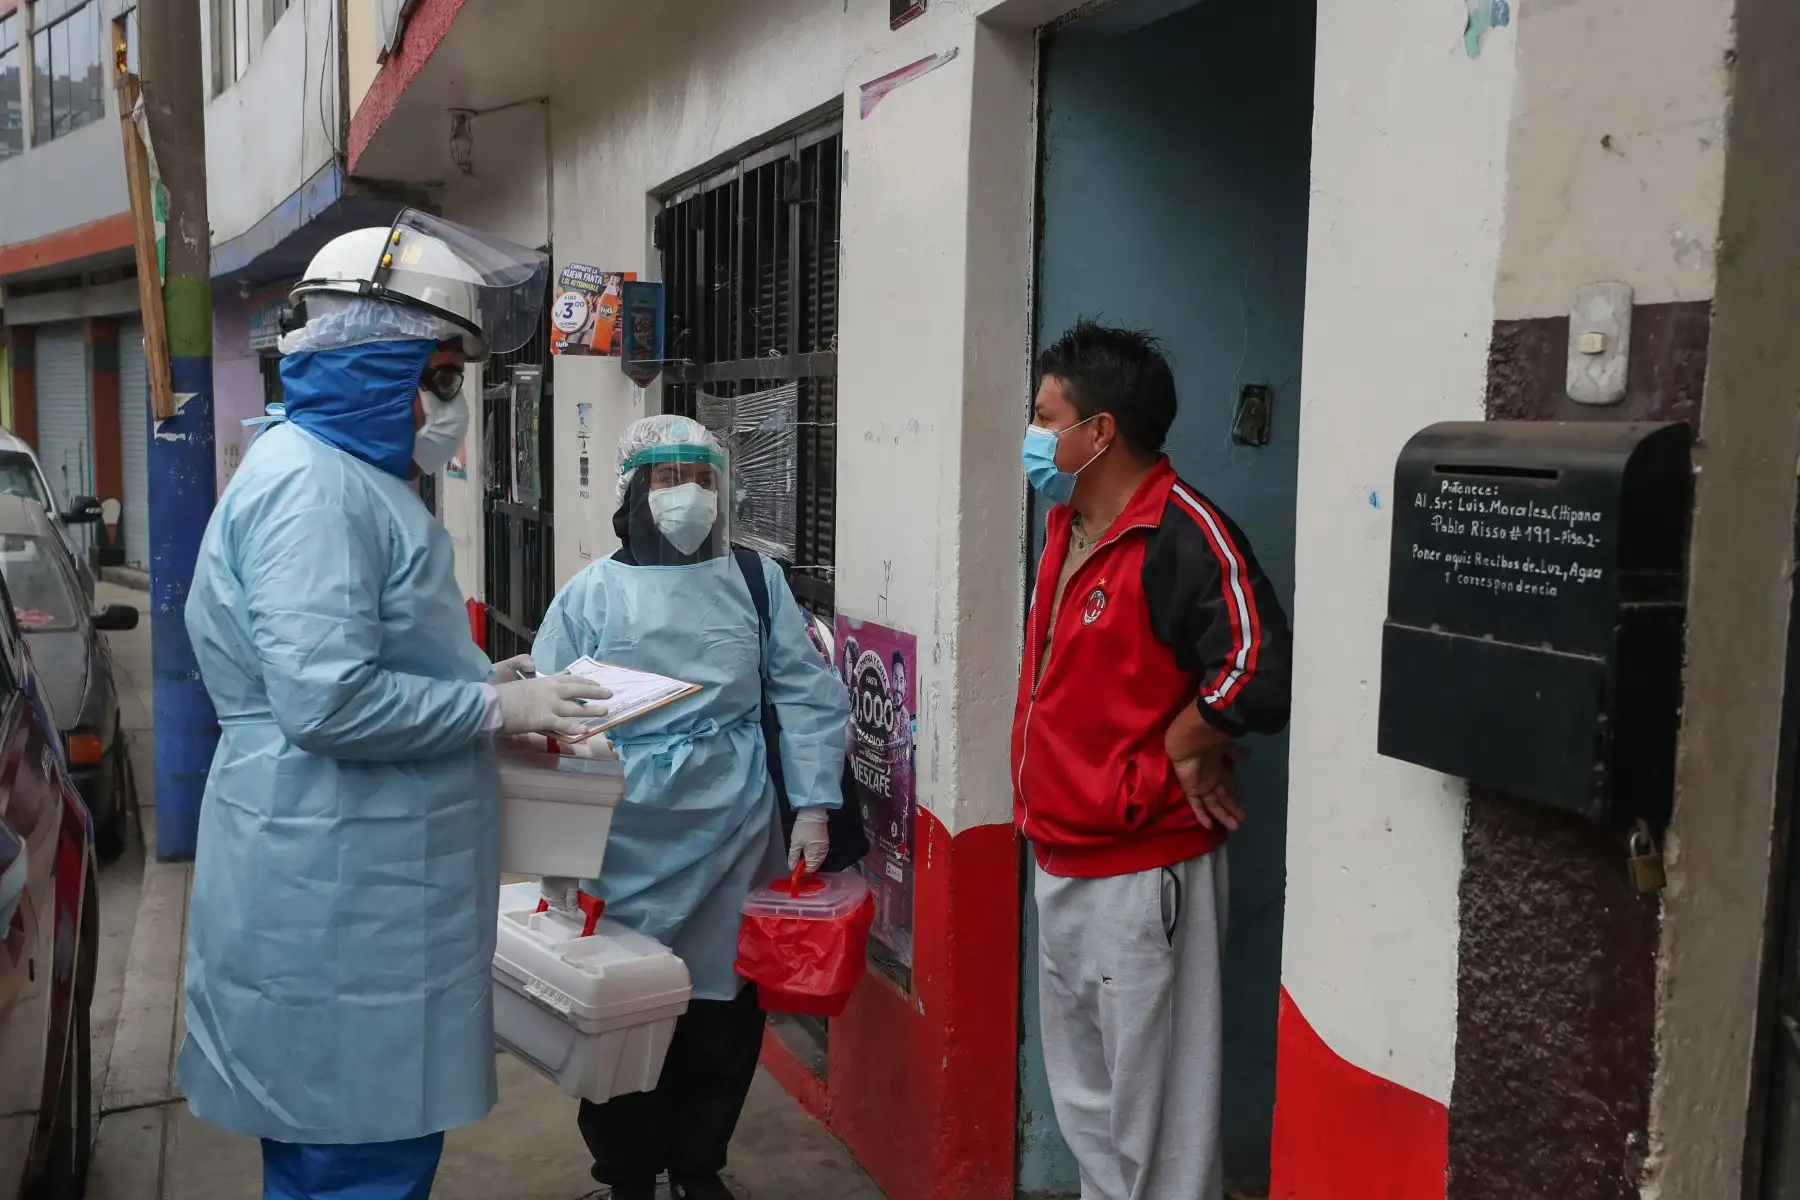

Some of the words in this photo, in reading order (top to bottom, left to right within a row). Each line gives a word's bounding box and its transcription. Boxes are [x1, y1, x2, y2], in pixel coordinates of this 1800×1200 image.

[562, 268, 583, 280] NUEVA
[583, 273, 603, 285] FANTA
[1431, 515, 1465, 535] Pablo
[1470, 520, 1506, 540] Risso
[1412, 544, 1441, 561] Poner
[1474, 552, 1520, 571] Recibos
[1569, 562, 1603, 583] Agua
[1456, 573, 1558, 597] correspondencia
[865, 675, 878, 687] HASTA
